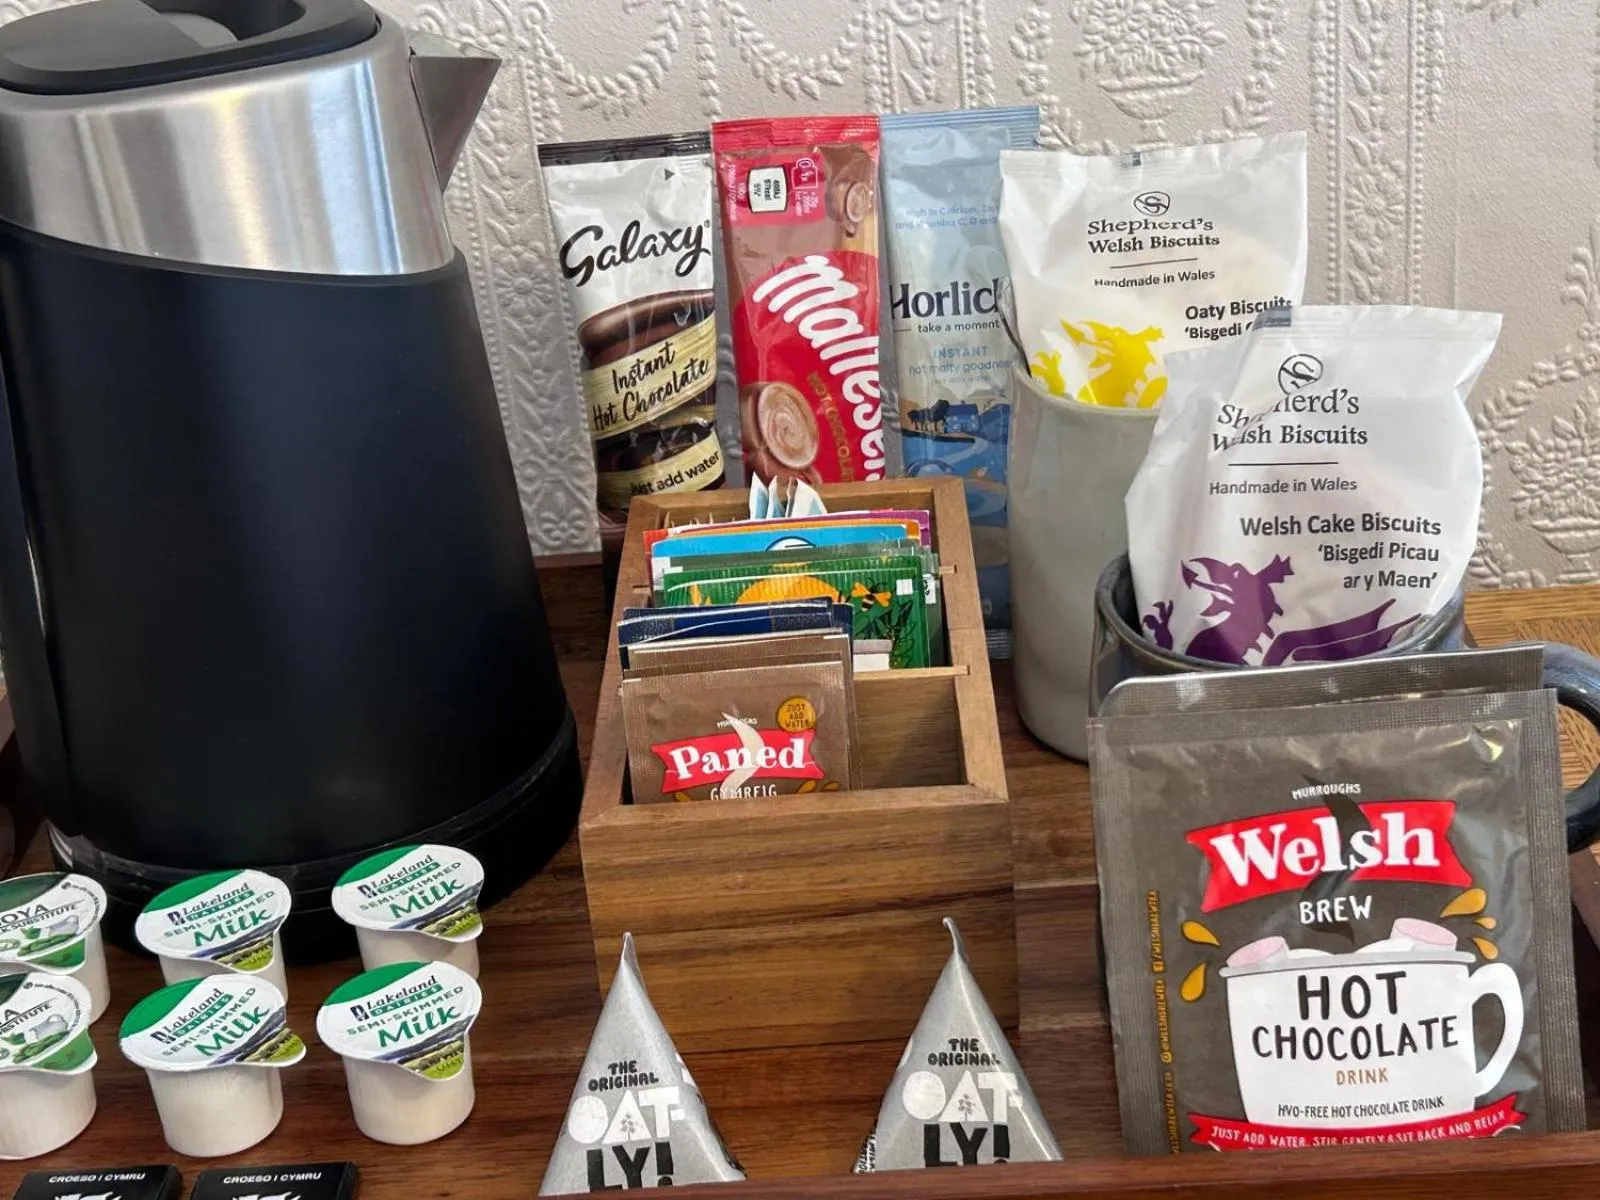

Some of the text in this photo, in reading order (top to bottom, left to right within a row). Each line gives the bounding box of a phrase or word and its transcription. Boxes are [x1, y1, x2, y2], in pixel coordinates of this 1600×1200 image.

[1087, 217, 1214, 235] Shepherd's
[559, 219, 711, 287] Galaxy
[1088, 234, 1220, 254] Welsh Biscuits
[1094, 269, 1215, 288] Handmade in Wales
[1185, 304, 1225, 320] Oaty
[917, 319, 1001, 333] take a moment
[1184, 322, 1242, 341] 'Bisgedi
[933, 345, 989, 359] INSTANT
[612, 341, 676, 394] Instant
[593, 357, 709, 432] Hot Chocolate
[1280, 424, 1368, 445] Biscuits
[656, 470, 684, 492] add
[684, 450, 720, 479] water
[1209, 476, 1357, 494] Handmade in Wales
[1240, 512, 1442, 536] Welsh Cake Biscuits
[1318, 542, 1439, 564] 'Bisgedi Picau
[1343, 570, 1438, 591] ar y Maen'
[787, 703, 805, 713] JUST
[789, 712, 804, 720] ADD
[784, 719, 810, 729] WATER
[669, 738, 805, 780] Paned
[1291, 783, 1362, 800] MURROUGHS
[1210, 811, 1441, 888] Welsh
[372, 854, 434, 888] Lakeland
[183, 882, 250, 915] Lakeland
[359, 862, 461, 910] SEMI-SKIMMED
[388, 879, 465, 918] Milk
[0, 904, 49, 925] OYA
[164, 891, 275, 937] SEMI-SKIMMED
[1299, 895, 1373, 924] BREW
[193, 909, 272, 947] Milk
[366, 975, 438, 1010] Lakeland
[373, 985, 441, 1015] DAIRIES
[1297, 970, 1407, 1020] HOT
[162, 987, 256, 1056] SEMI-SKIMMED
[163, 988, 225, 1033] Lakeland
[346, 986, 464, 1035] SEMI-SKIMMED
[194, 1006, 270, 1057] Milk
[377, 1006, 461, 1048] Milk
[1252, 1015, 1459, 1061] CHOCOLATE
[948, 1038, 980, 1052] THE
[608, 1060, 638, 1075] THE
[927, 1052, 1001, 1066] ORIGINAL
[588, 1072, 660, 1091] ORIGINAL
[1336, 1067, 1389, 1086] DRINK
[1278, 1096, 1445, 1118] HVO-FREE HOT CHOCOLATE DRINK
[1211, 1125, 1240, 1140] JUST
[1243, 1133, 1265, 1145] ADD
[1312, 1136, 1338, 1147] STIR
[1395, 1131, 1414, 1143] SIT
[1417, 1128, 1446, 1141] BACK
[1449, 1121, 1471, 1135] AND
[1474, 1110, 1506, 1130] RELAX
[923, 1121, 1011, 1168] LY!
[48, 1174, 97, 1183] CROESO
[104, 1172, 146, 1181] CYMRU
[223, 1174, 272, 1184] CROESO
[280, 1172, 322, 1182] CYMRU
[586, 1141, 674, 1192] LY!
